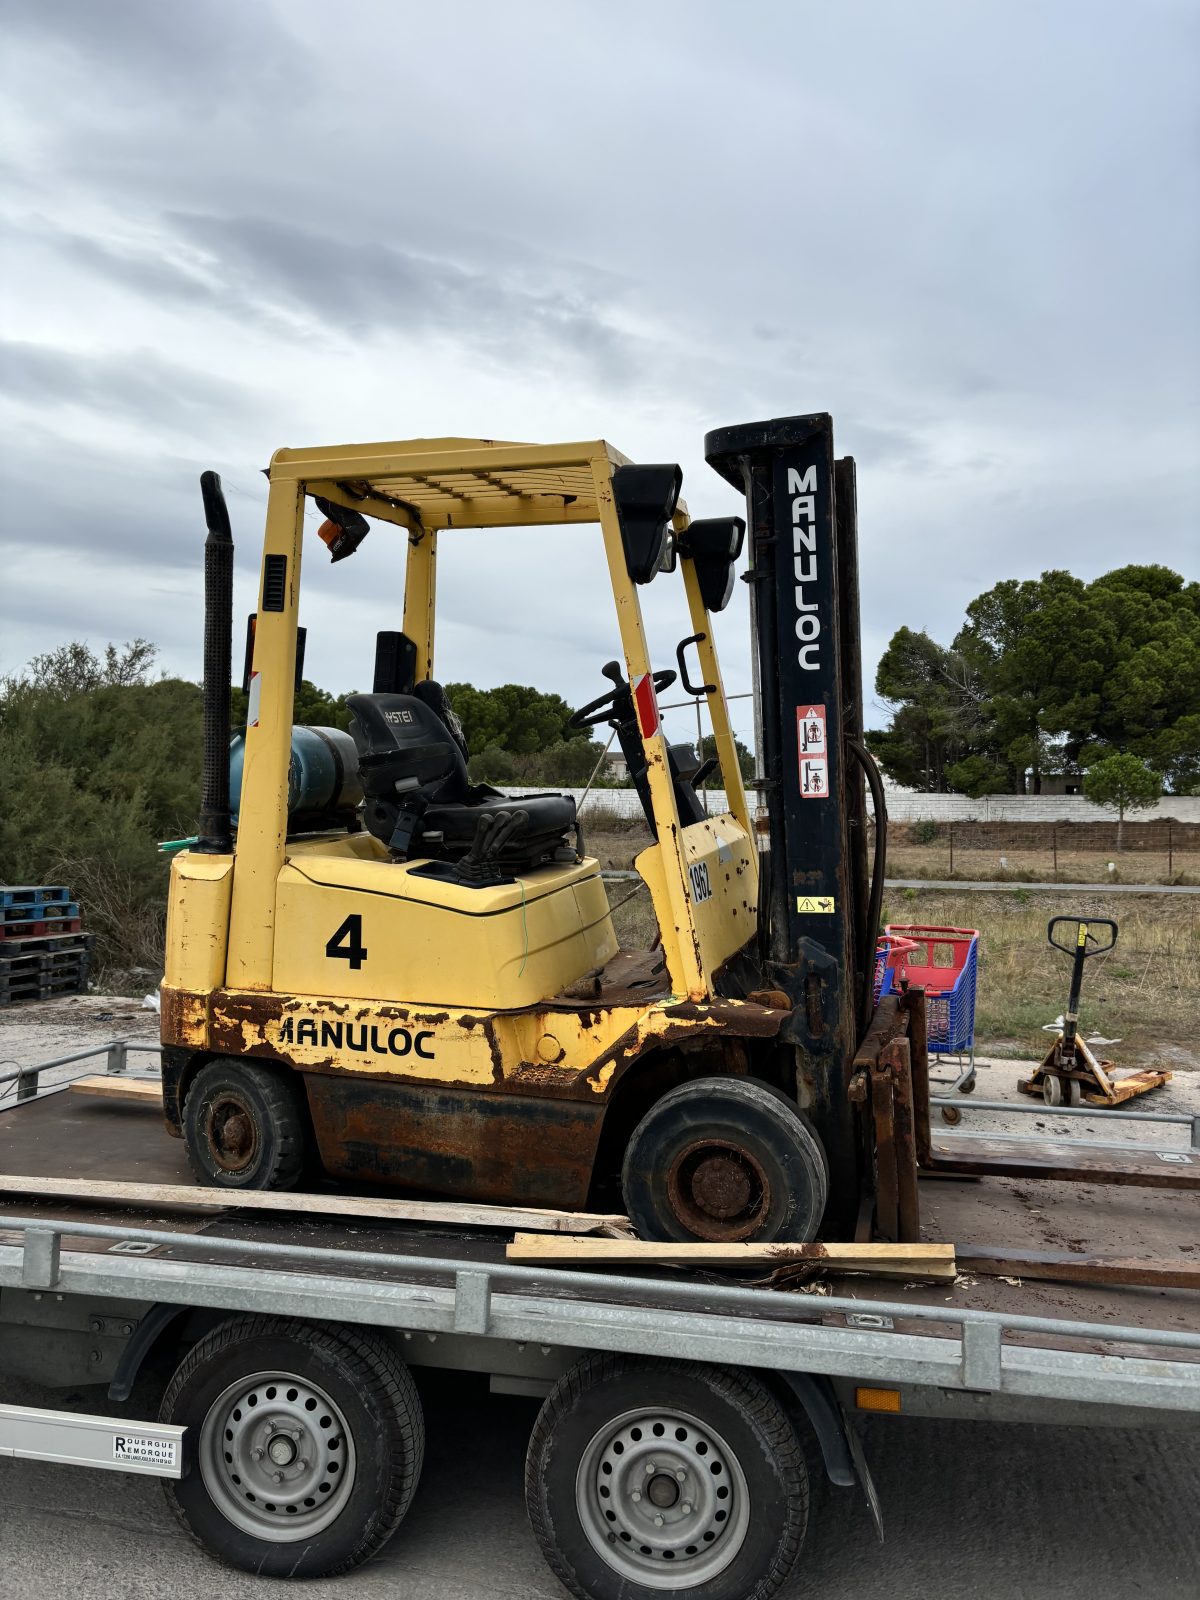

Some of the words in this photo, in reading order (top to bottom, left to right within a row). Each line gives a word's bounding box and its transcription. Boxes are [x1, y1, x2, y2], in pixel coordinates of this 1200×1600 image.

[787, 464, 821, 670] MANULOC
[689, 862, 712, 903] 1962
[325, 913, 368, 970] 4
